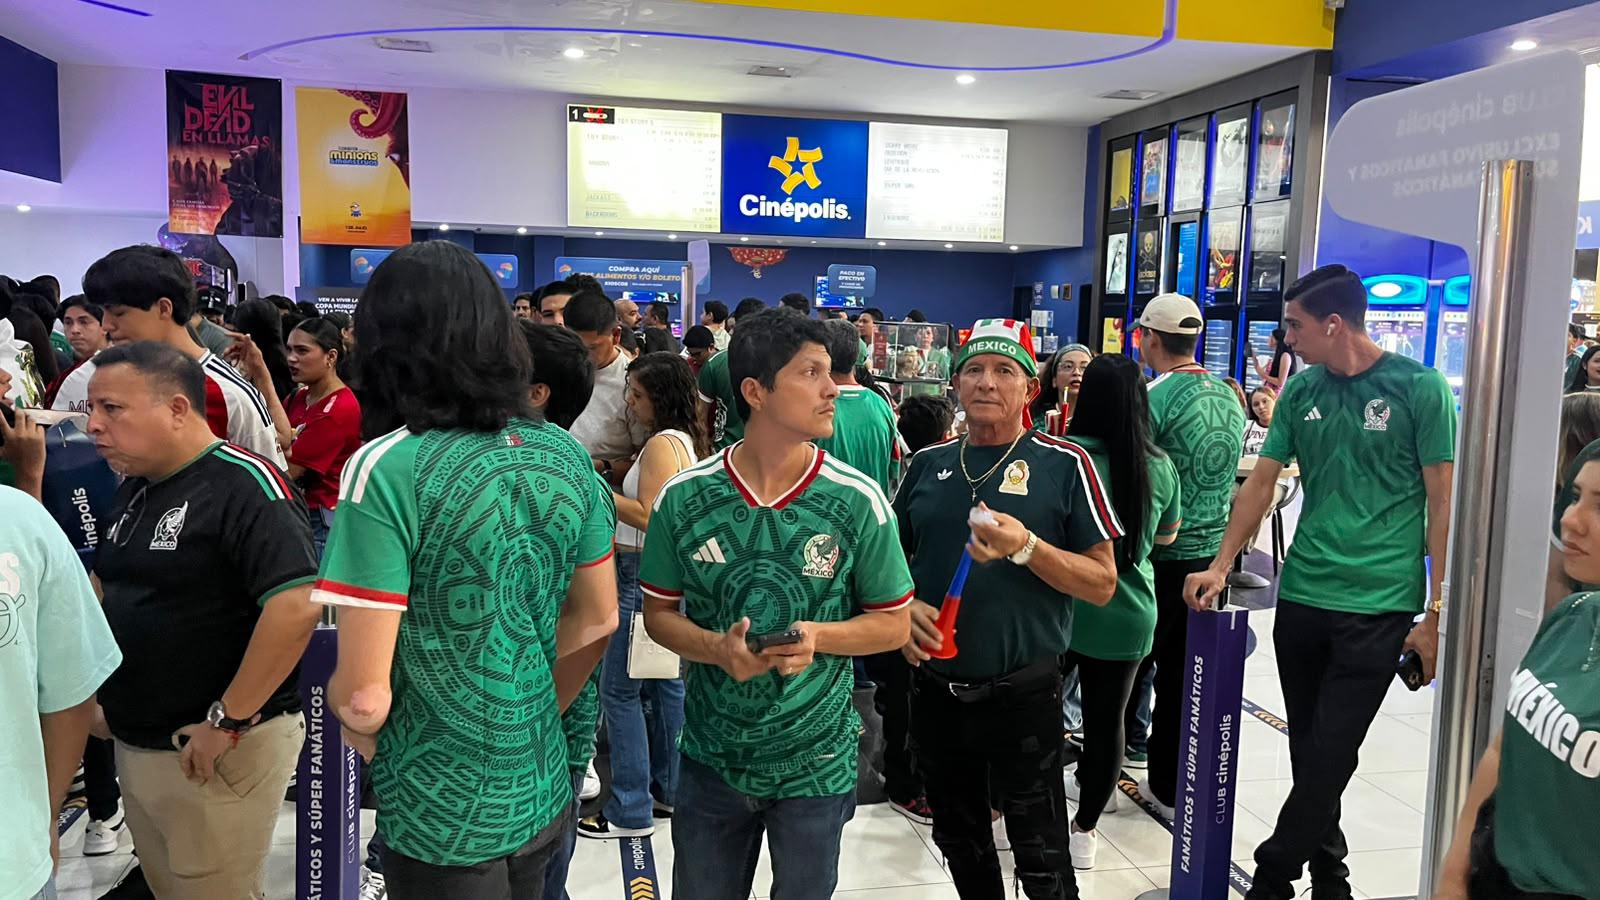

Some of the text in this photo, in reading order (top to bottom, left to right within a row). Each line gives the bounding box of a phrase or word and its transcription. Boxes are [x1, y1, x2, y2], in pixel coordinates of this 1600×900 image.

[203, 84, 254, 111] EVIL
[184, 105, 251, 133] DEAD
[572, 109, 579, 120] 1
[183, 130, 270, 145] EN LLAMAS
[329, 151, 379, 161] minions
[596, 272, 637, 280] ALIMENTOS
[967, 341, 1017, 355] MEXICO
[71, 487, 98, 549] inépolis
[1506, 665, 1600, 778] MÉXICO
[1181, 655, 1203, 874] FANÁTICOS Y SÚPER FANÁTICOS
[1216, 714, 1232, 824] CLUB cinépolis
[307, 686, 324, 900] ÁTICOS Y SÚPER FANÁTICOS
[346, 747, 356, 820] cinépoli
